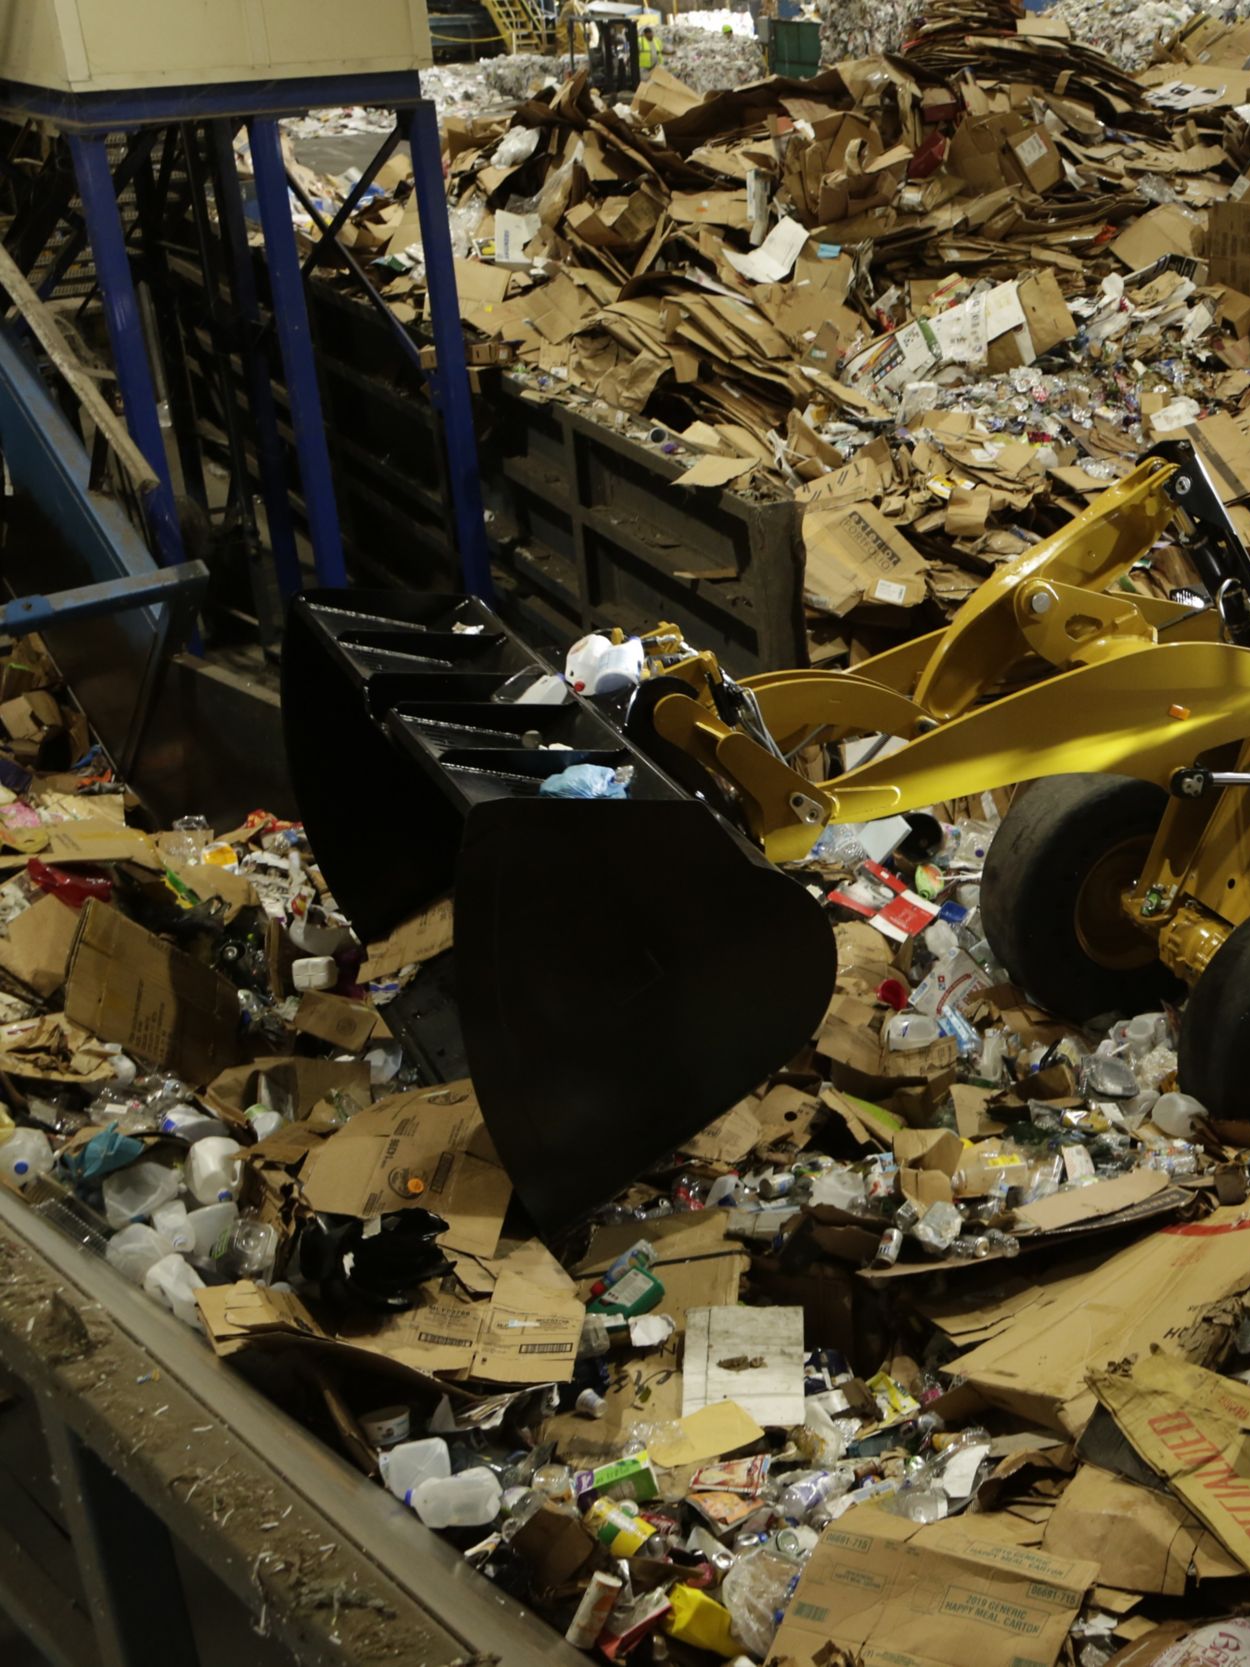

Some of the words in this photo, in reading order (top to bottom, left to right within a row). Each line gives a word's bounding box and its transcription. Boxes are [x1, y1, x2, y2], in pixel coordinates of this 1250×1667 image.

[944, 1600, 974, 1615] HAPPY
[1003, 1616, 1041, 1634] CARTON
[988, 1601, 1028, 1620] GENERIC
